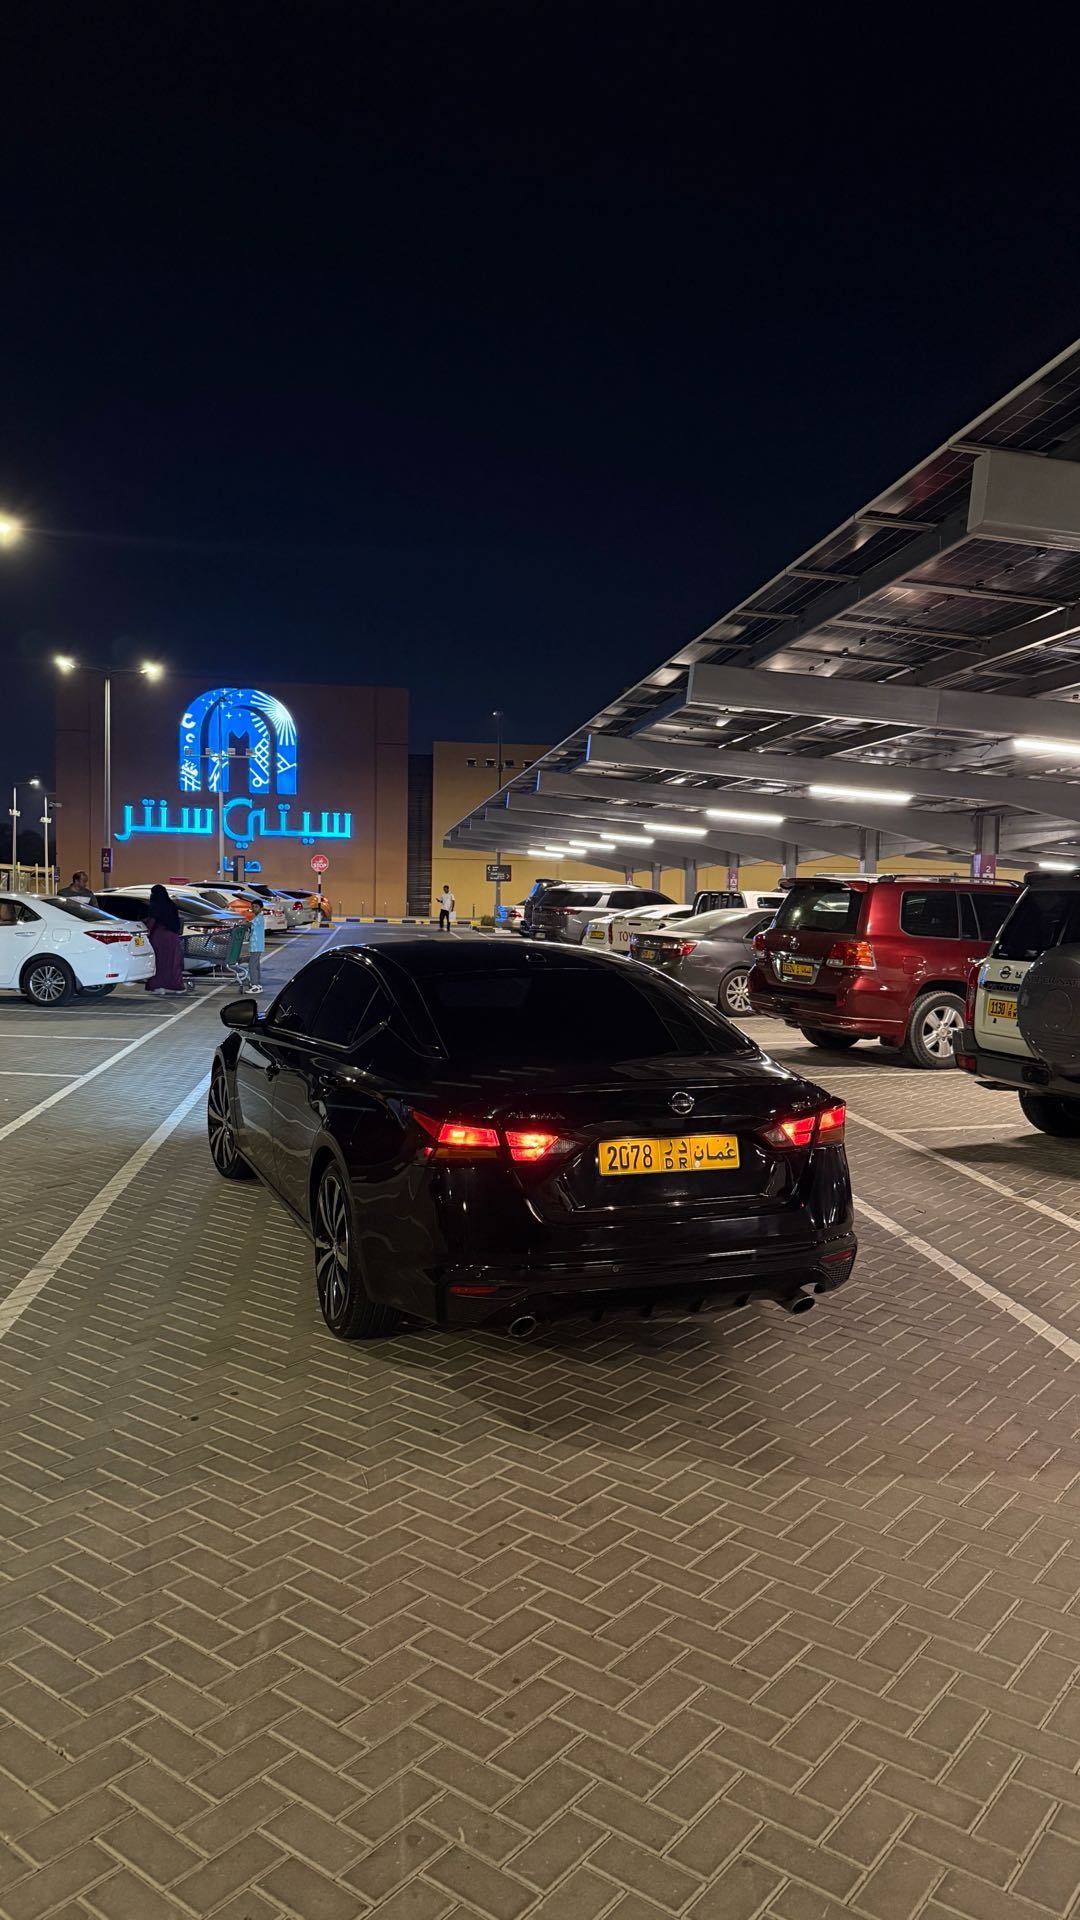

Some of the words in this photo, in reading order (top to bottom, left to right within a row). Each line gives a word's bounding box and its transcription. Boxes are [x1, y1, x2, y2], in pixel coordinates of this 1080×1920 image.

[114, 798, 214, 841] سنتر
[223, 797, 351, 849] سيتي
[985, 865, 992, 873] 2
[991, 1001, 1006, 1015] 1130
[606, 1143, 653, 1171] 2078
